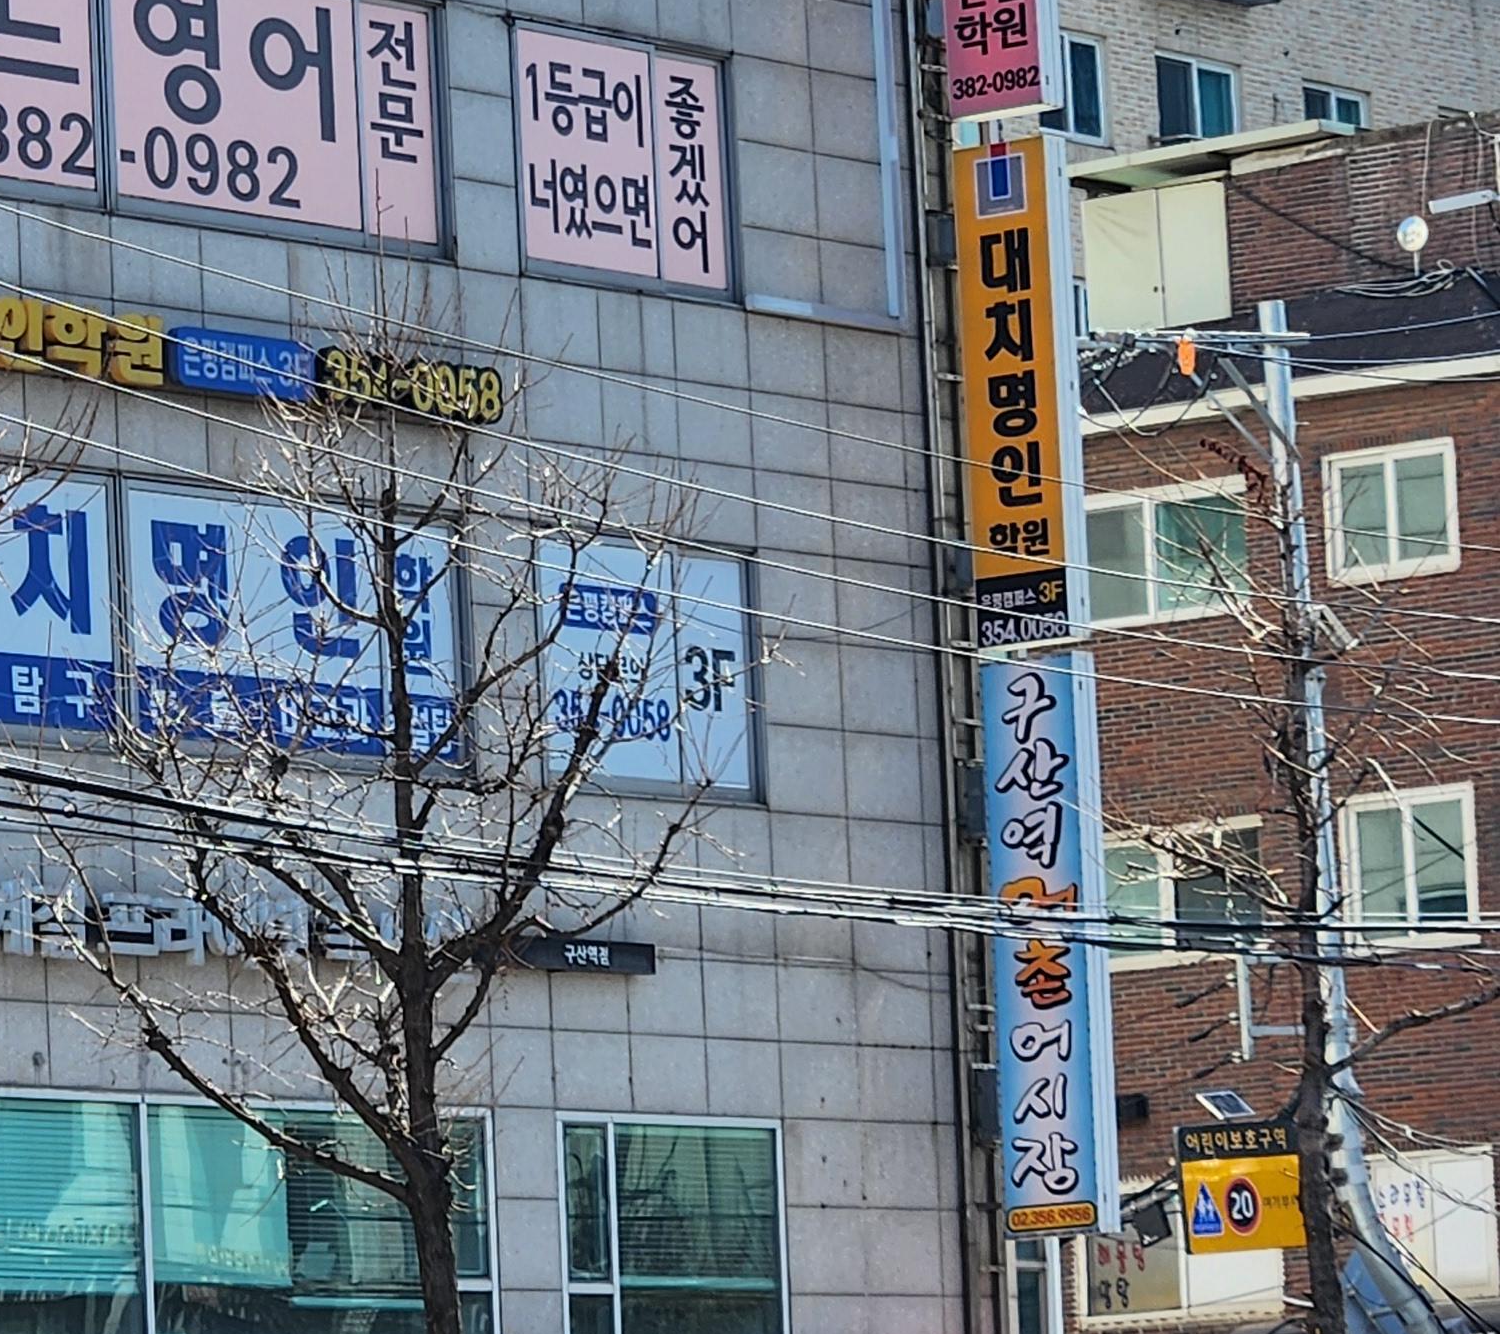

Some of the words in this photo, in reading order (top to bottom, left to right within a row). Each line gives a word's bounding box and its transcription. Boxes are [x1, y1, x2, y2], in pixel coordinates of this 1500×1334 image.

[953, 3, 1029, 56] 학원
[366, 18, 426, 165] 전문
[525, 61, 645, 148] 1등급이
[663, 75, 710, 274] 좋겠어
[529, 158, 653, 251] 너였으면
[988, 517, 1051, 557] 학원
[1038, 580, 1064, 604] 3F
[1184, 1128, 1288, 1156] 어린이보호구역
[1011, 1208, 1093, 1230] 02.356.9956
[1229, 1189, 1256, 1221] 20
